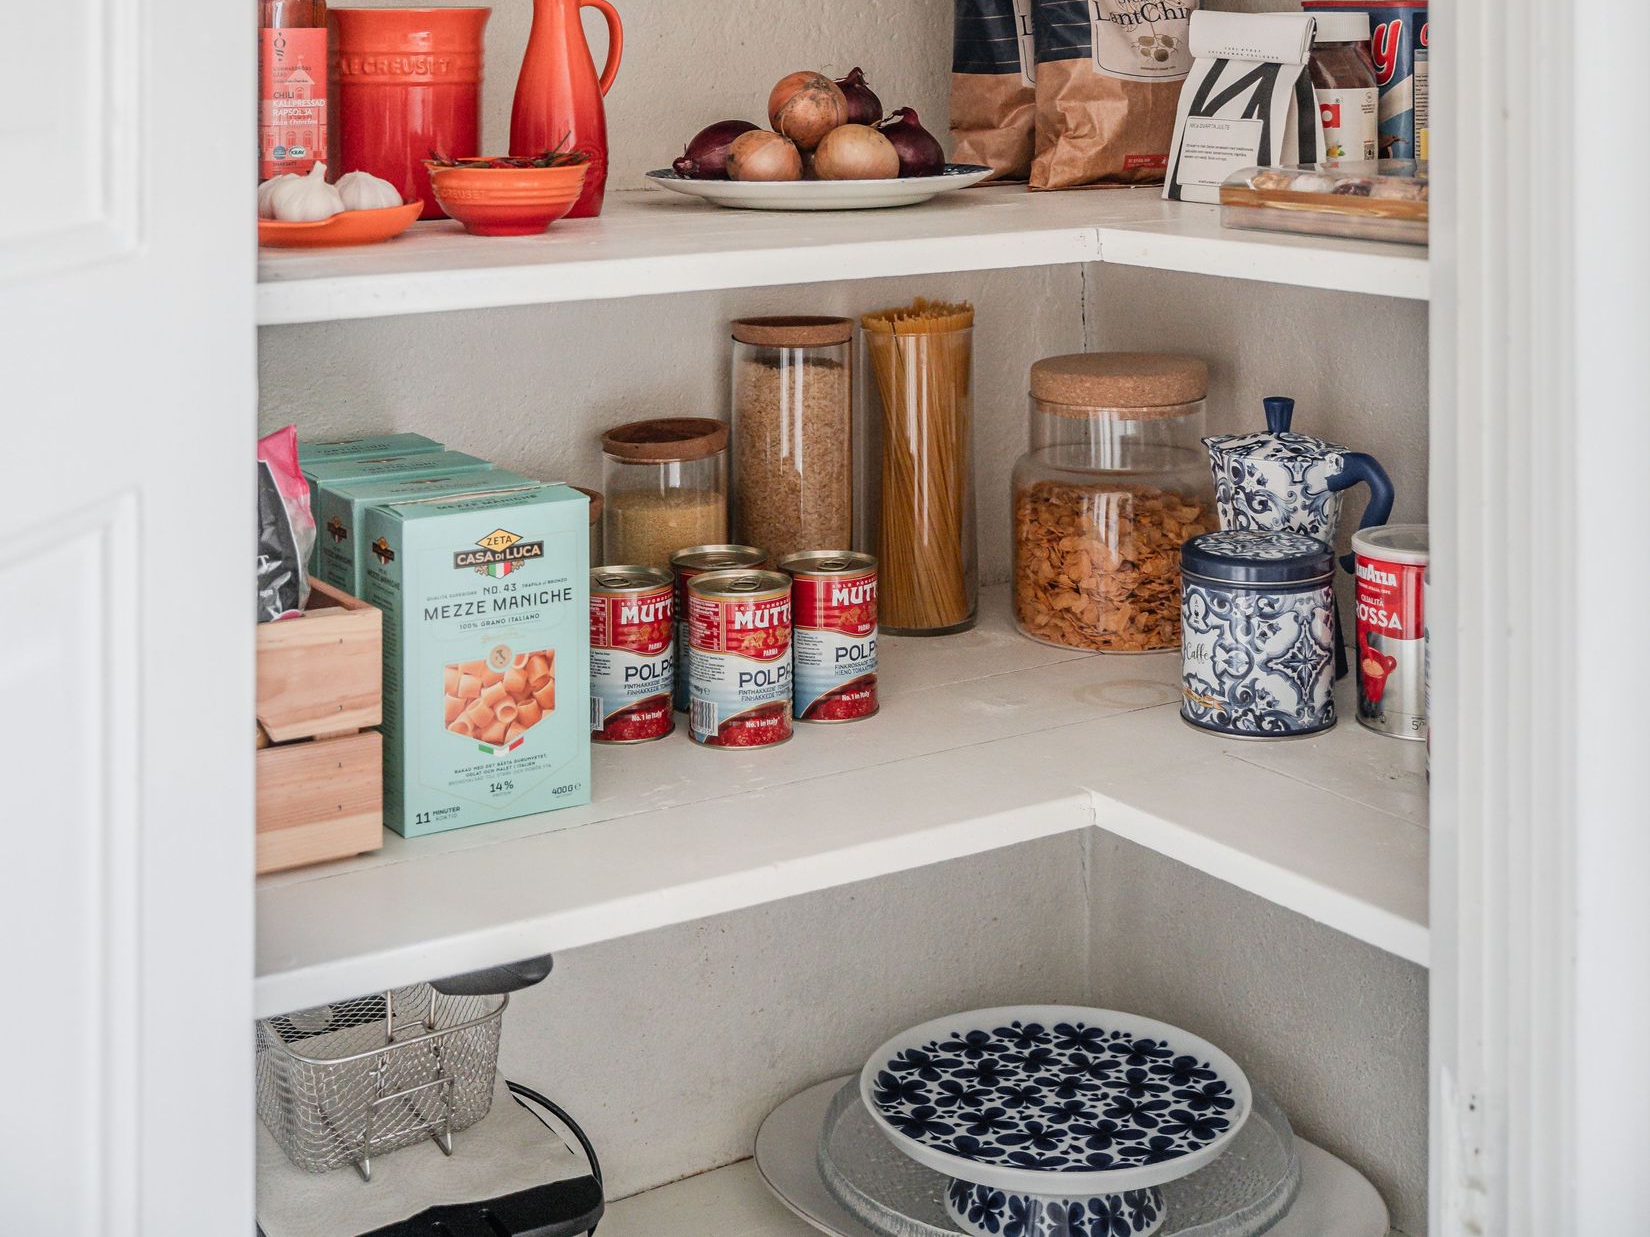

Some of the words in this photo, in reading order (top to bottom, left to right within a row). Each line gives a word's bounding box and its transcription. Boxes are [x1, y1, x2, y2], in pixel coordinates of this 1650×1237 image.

[273, 91, 295, 99] CHILI
[486, 535, 513, 546] ZETA
[456, 551, 494, 566] CASA
[506, 545, 541, 560] LUCA
[831, 581, 878, 607] MUTT
[424, 600, 486, 621] MEZZE
[493, 588, 572, 612] MANICHE
[620, 600, 673, 625] MUTT
[459, 622, 478, 630] 100%
[480, 618, 505, 627] GRANO
[508, 613, 540, 624] ITALIANO
[738, 662, 791, 688] POLPA
[746, 720, 756, 728] No.
[761, 719, 766, 727] in
[490, 782, 503, 793] 14
[415, 812, 431, 825] 11
[433, 806, 460, 816] MINUTER
